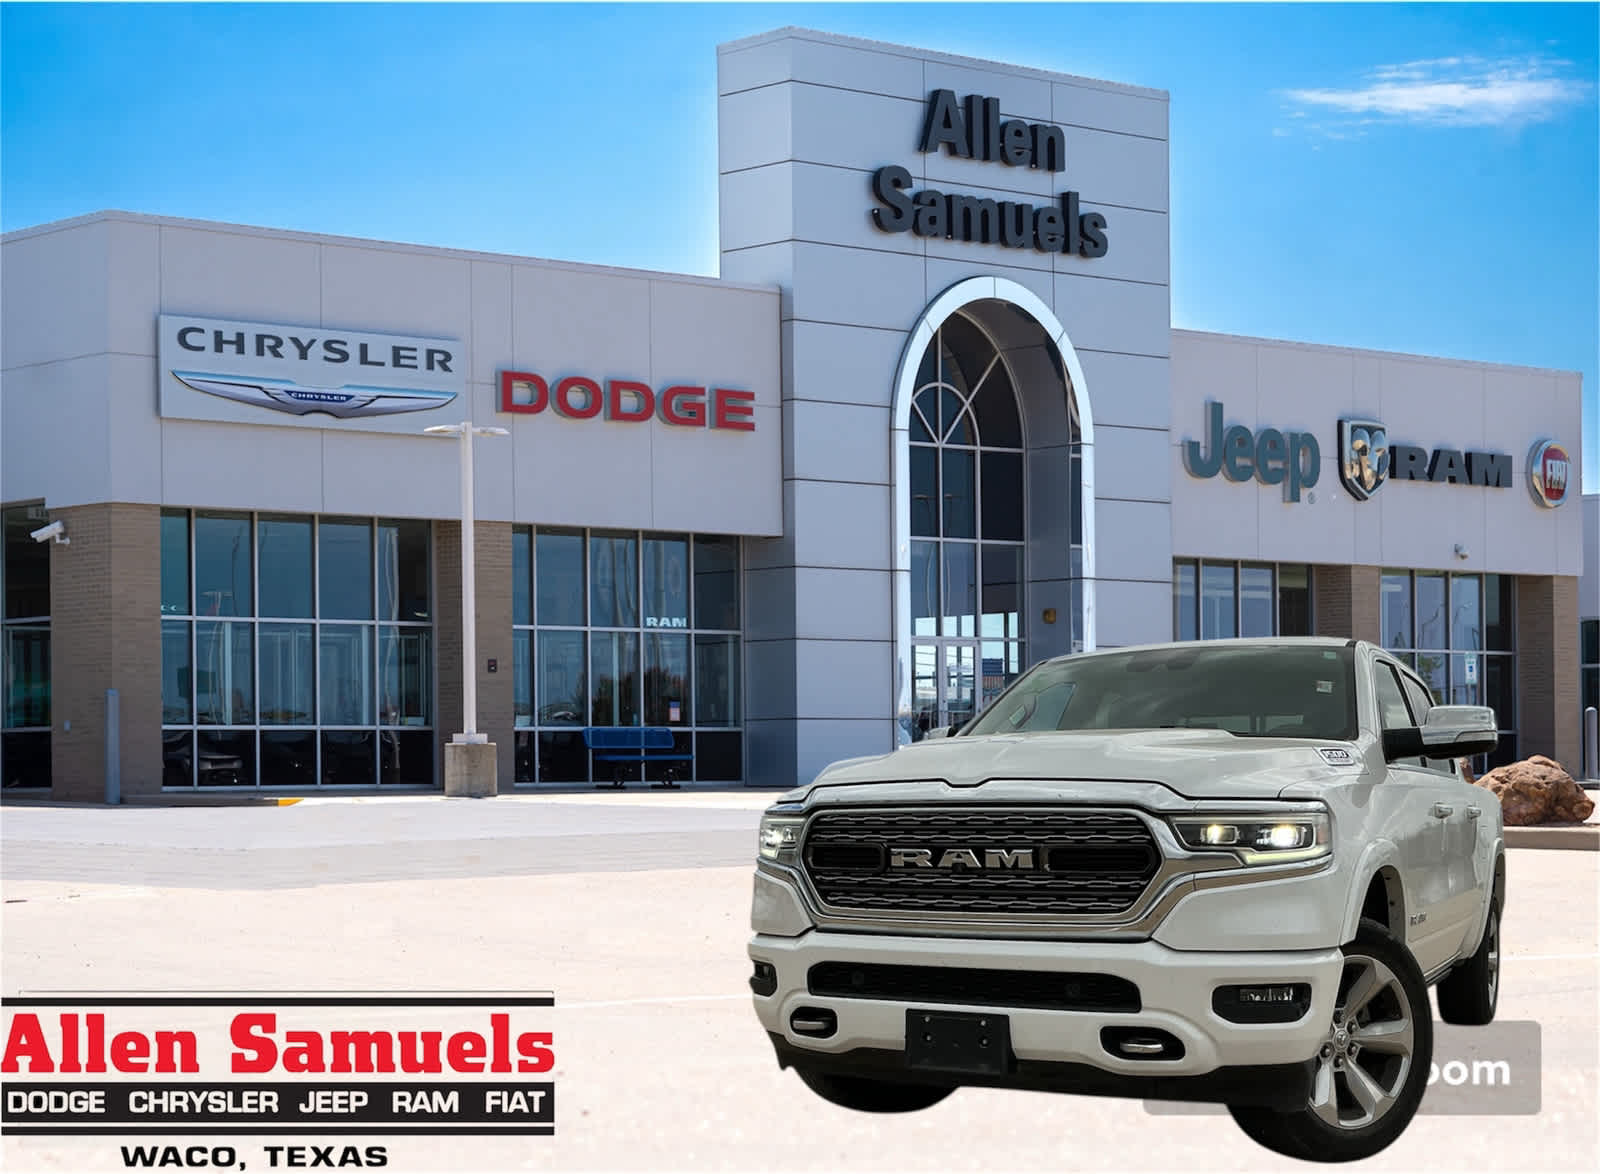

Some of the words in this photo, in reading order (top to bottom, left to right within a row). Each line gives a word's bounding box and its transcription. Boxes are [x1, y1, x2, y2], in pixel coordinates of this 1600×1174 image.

[919, 88, 1066, 173] Allen
[871, 164, 1109, 258] Samuels
[176, 326, 454, 374] CHRYSLER
[290, 391, 347, 402] CHRYSLER
[497, 370, 756, 432] DODGE
[1183, 401, 1321, 504] Jeep
[1389, 445, 1513, 488] RAM
[646, 616, 688, 628] RAM
[890, 847, 1034, 870] RAM
